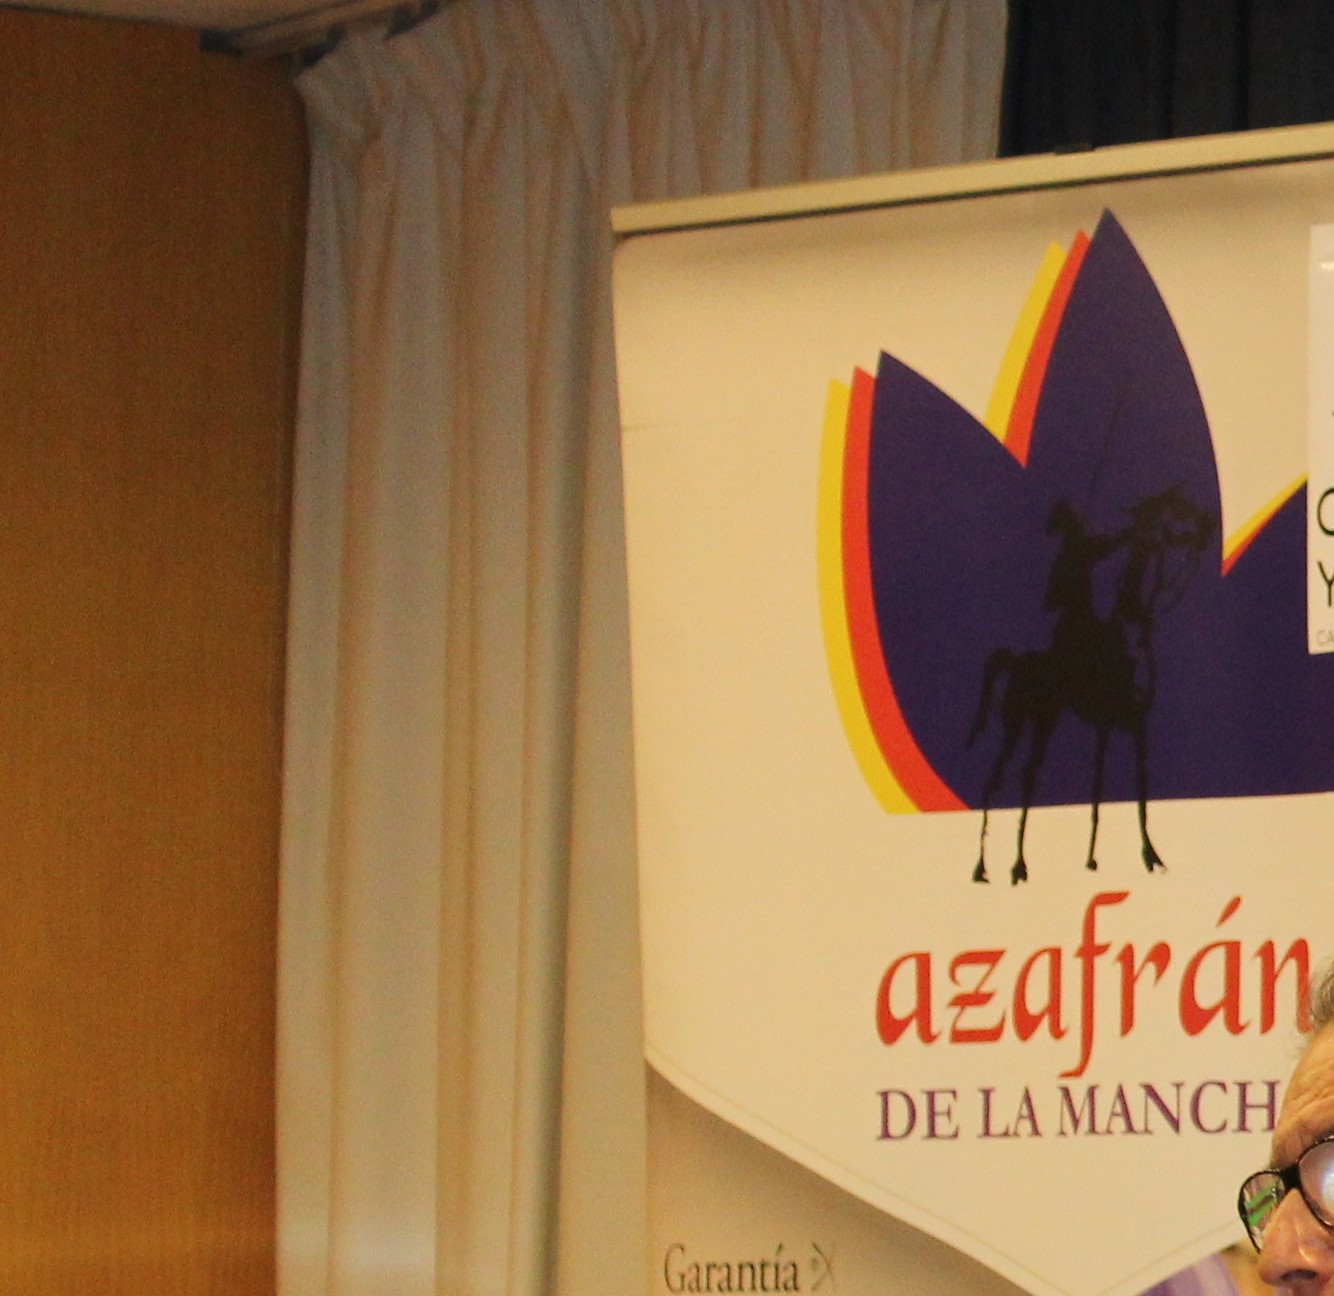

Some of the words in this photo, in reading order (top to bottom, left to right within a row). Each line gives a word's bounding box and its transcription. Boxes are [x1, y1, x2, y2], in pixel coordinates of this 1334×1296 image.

[875, 891, 1312, 1078] azafrán
[876, 1087, 961, 1141] DE
[977, 1084, 1042, 1139] LA
[1058, 1080, 1280, 1137] MANCH
[664, 1242, 800, 1295] Garantía
